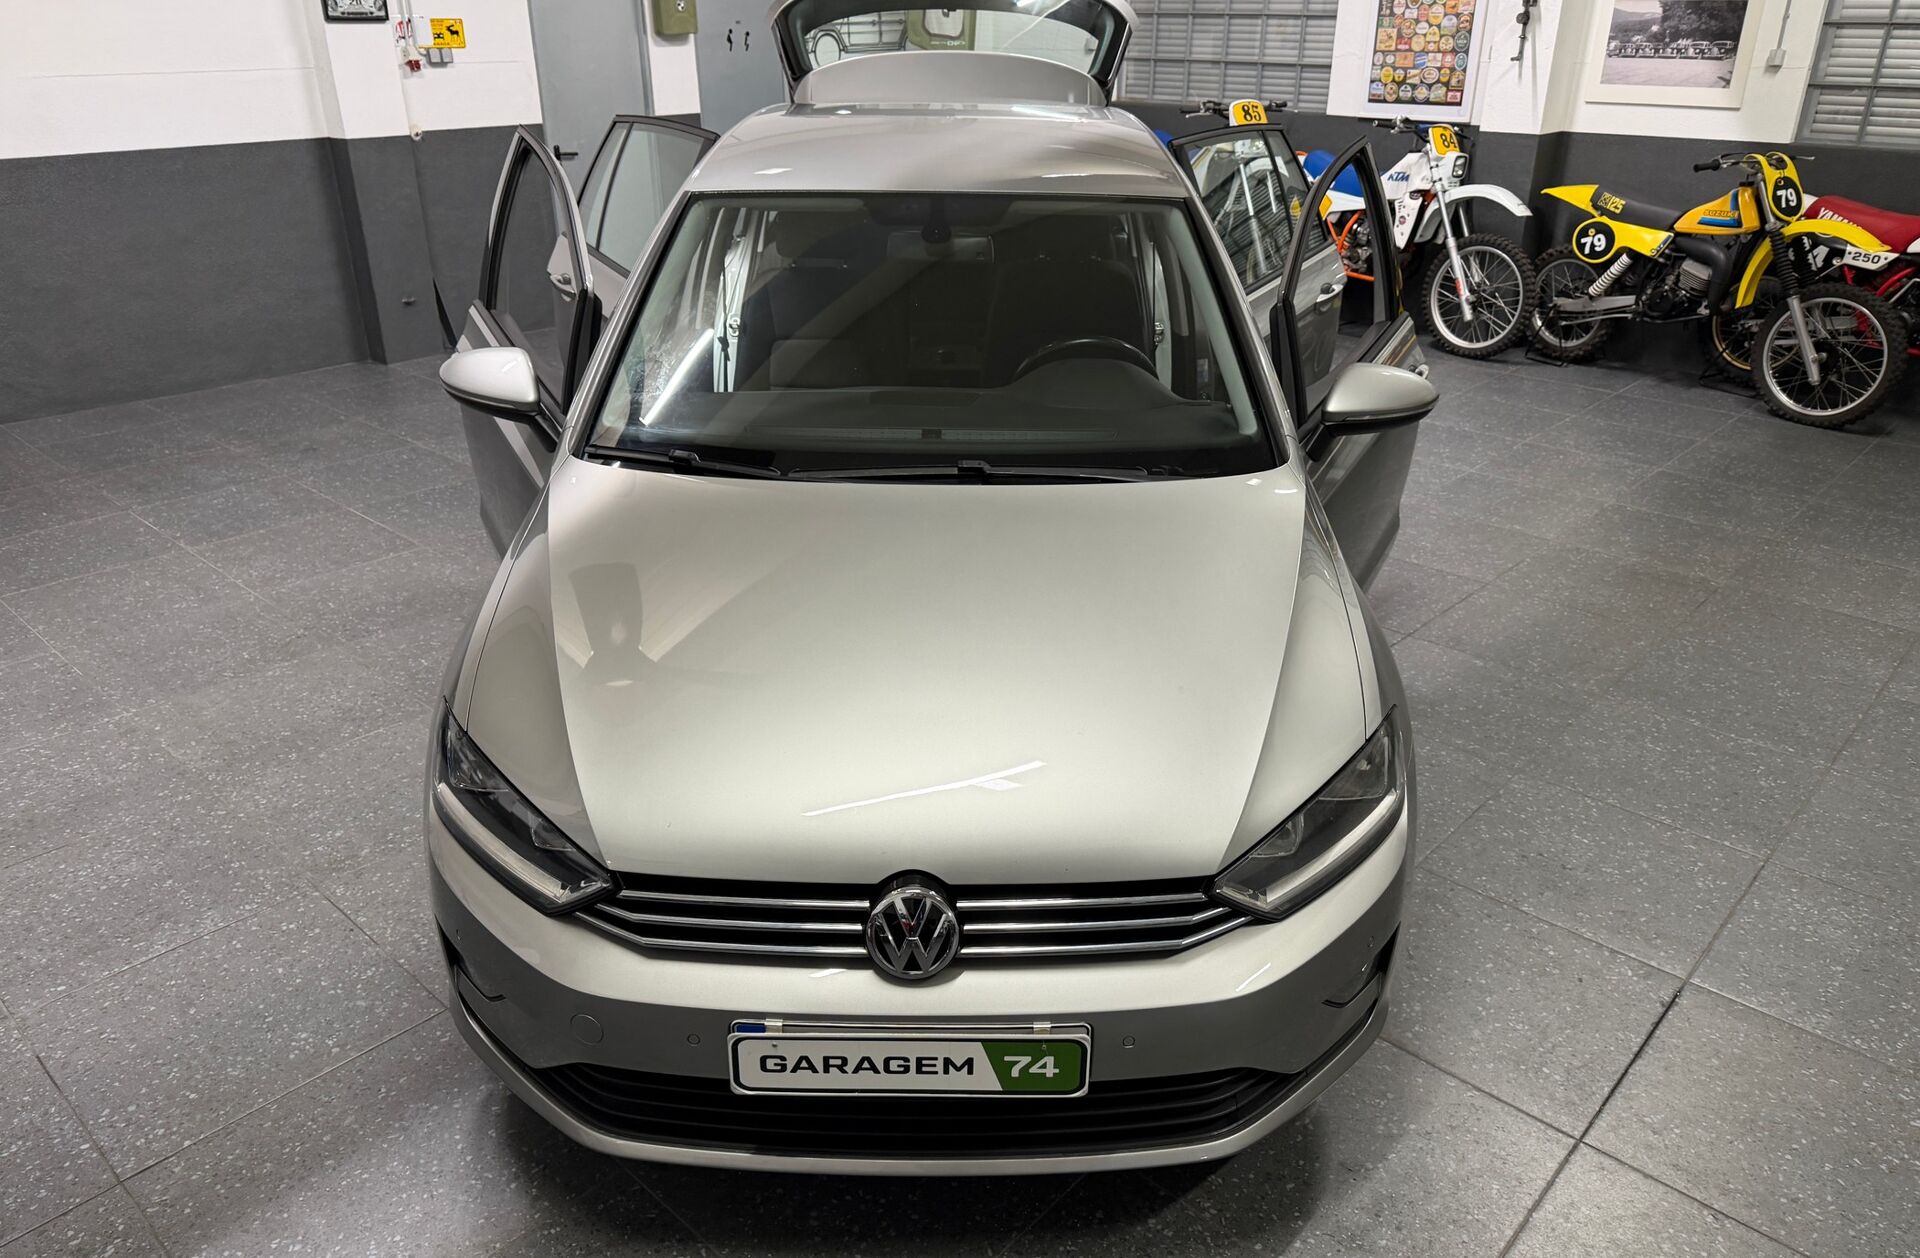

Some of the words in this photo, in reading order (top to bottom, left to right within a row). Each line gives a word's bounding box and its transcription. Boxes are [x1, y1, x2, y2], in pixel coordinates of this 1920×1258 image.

[1241, 104, 1262, 122] 85
[1440, 132, 1457, 149] 84
[1387, 171, 1410, 182] KTM
[1776, 188, 1797, 208] 79
[1703, 209, 1740, 219] SUZUKI
[1580, 233, 1607, 255] 79
[1852, 251, 1881, 264] 250
[759, 1054, 974, 1076] GARAGEM
[1003, 1055, 1060, 1077] 74
